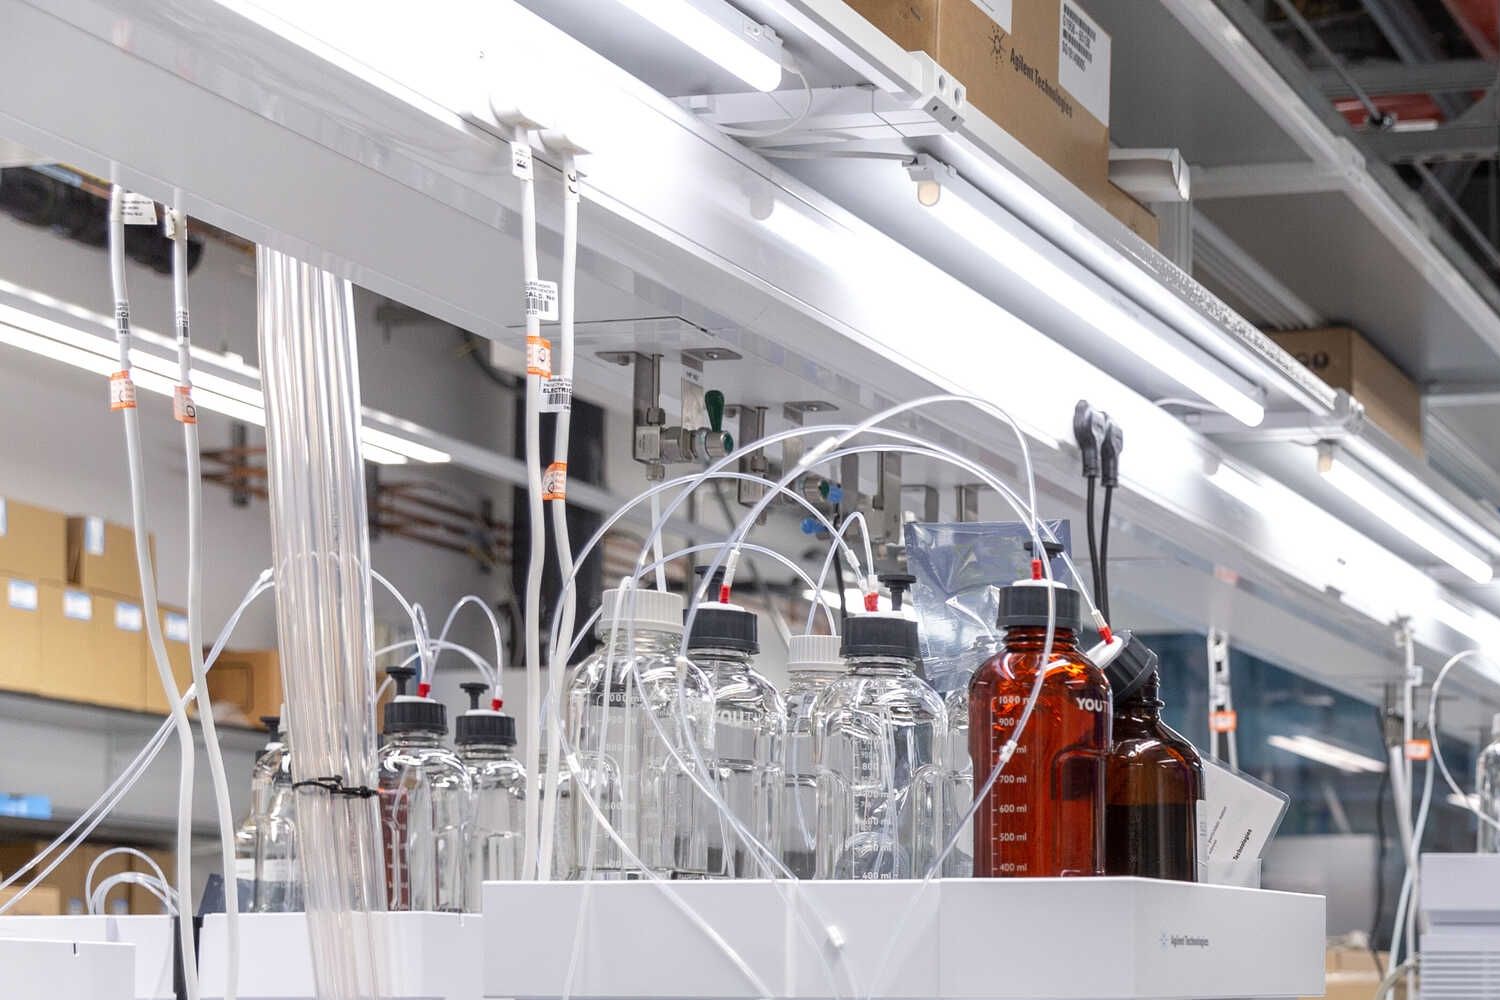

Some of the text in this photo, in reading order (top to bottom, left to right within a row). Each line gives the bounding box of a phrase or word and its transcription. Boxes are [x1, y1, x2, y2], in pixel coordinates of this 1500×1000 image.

[1010, 47, 1073, 119] Agilent Technologies
[999, 695, 1021, 705] 1000
[999, 717, 1015, 727] 900
[999, 774, 1027, 784] 700 ml
[999, 804, 1027, 814] 600 ml
[999, 832, 1027, 842] 500 ml
[999, 863, 1027, 873] 400 ml
